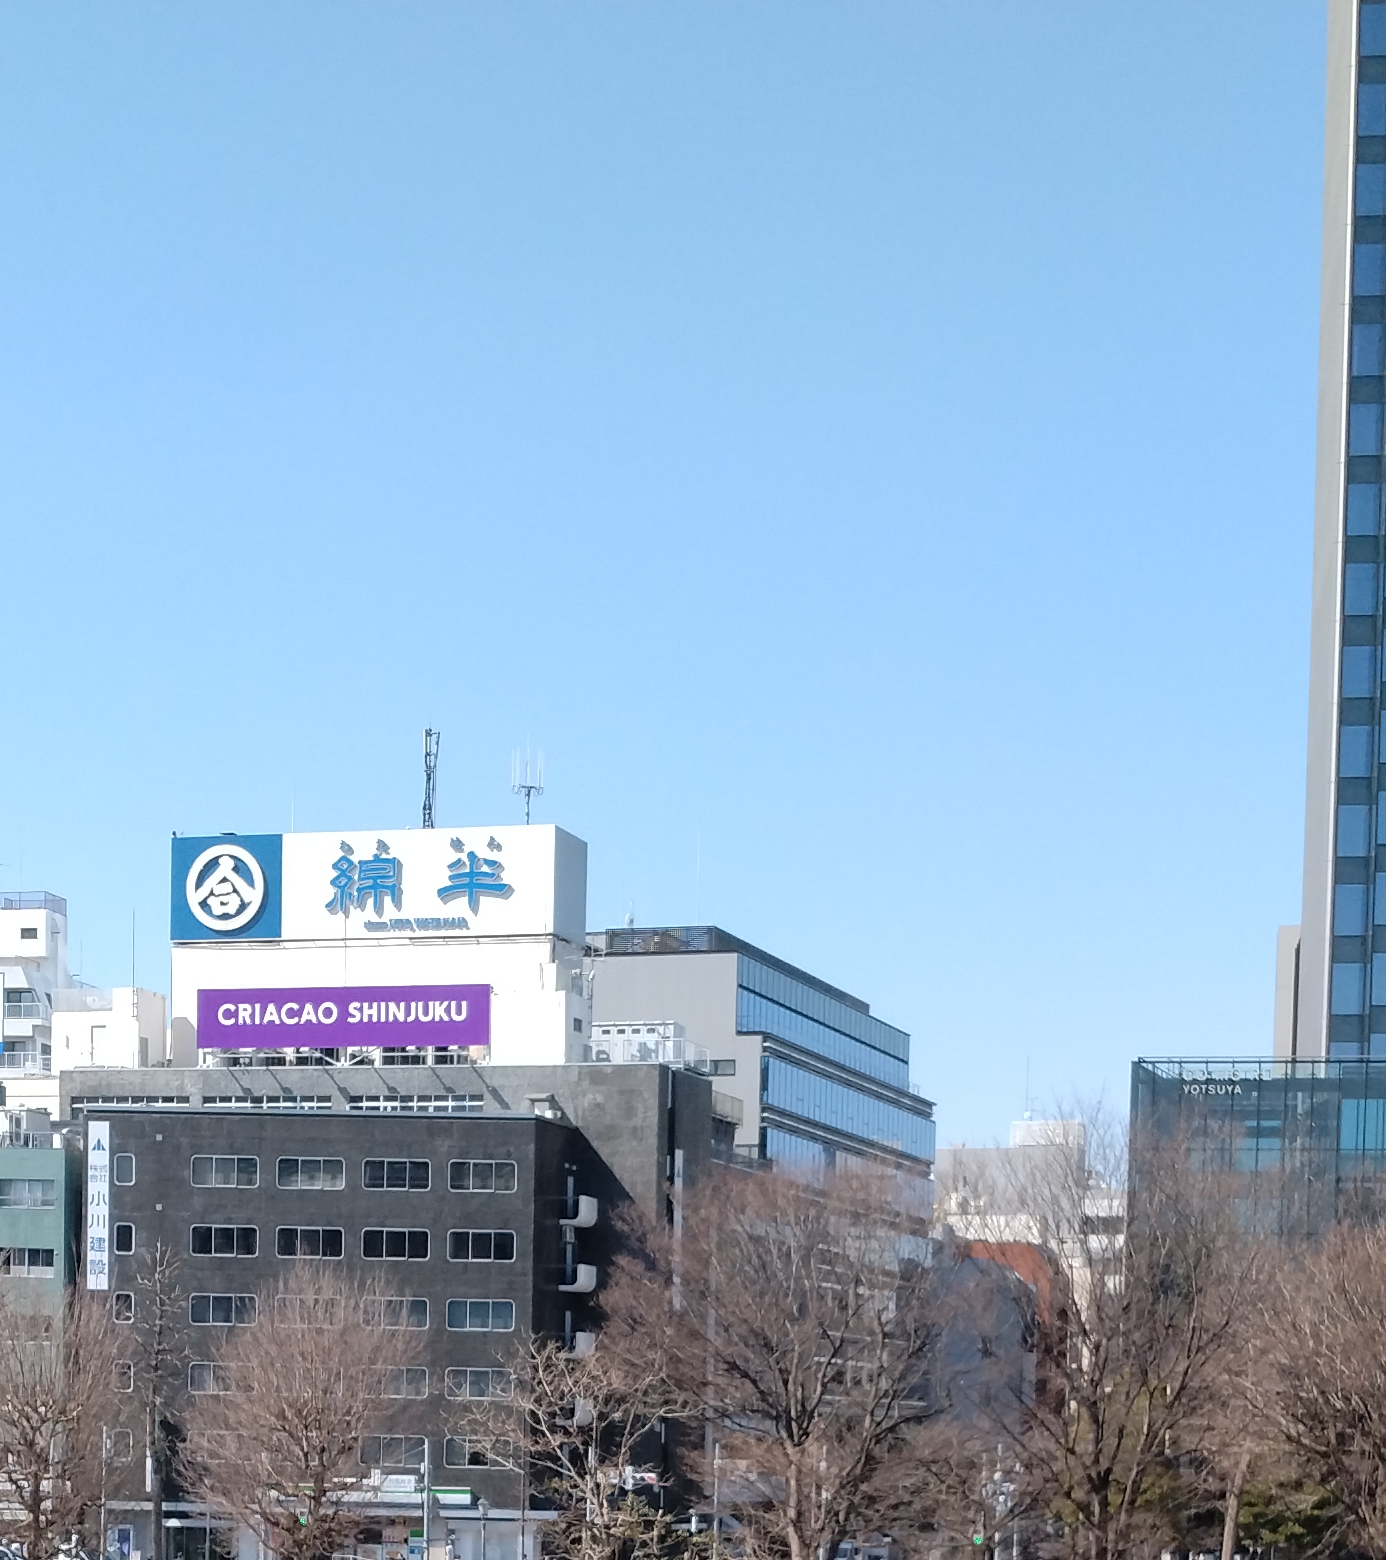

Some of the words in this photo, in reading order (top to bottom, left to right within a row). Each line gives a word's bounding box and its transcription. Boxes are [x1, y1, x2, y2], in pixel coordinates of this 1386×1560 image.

[325, 850, 511, 914] 綿半
[217, 1001, 338, 1026] CRIACAO
[347, 999, 468, 1024] SHINJUKU
[1182, 1084, 1243, 1095] YOTSUYA
